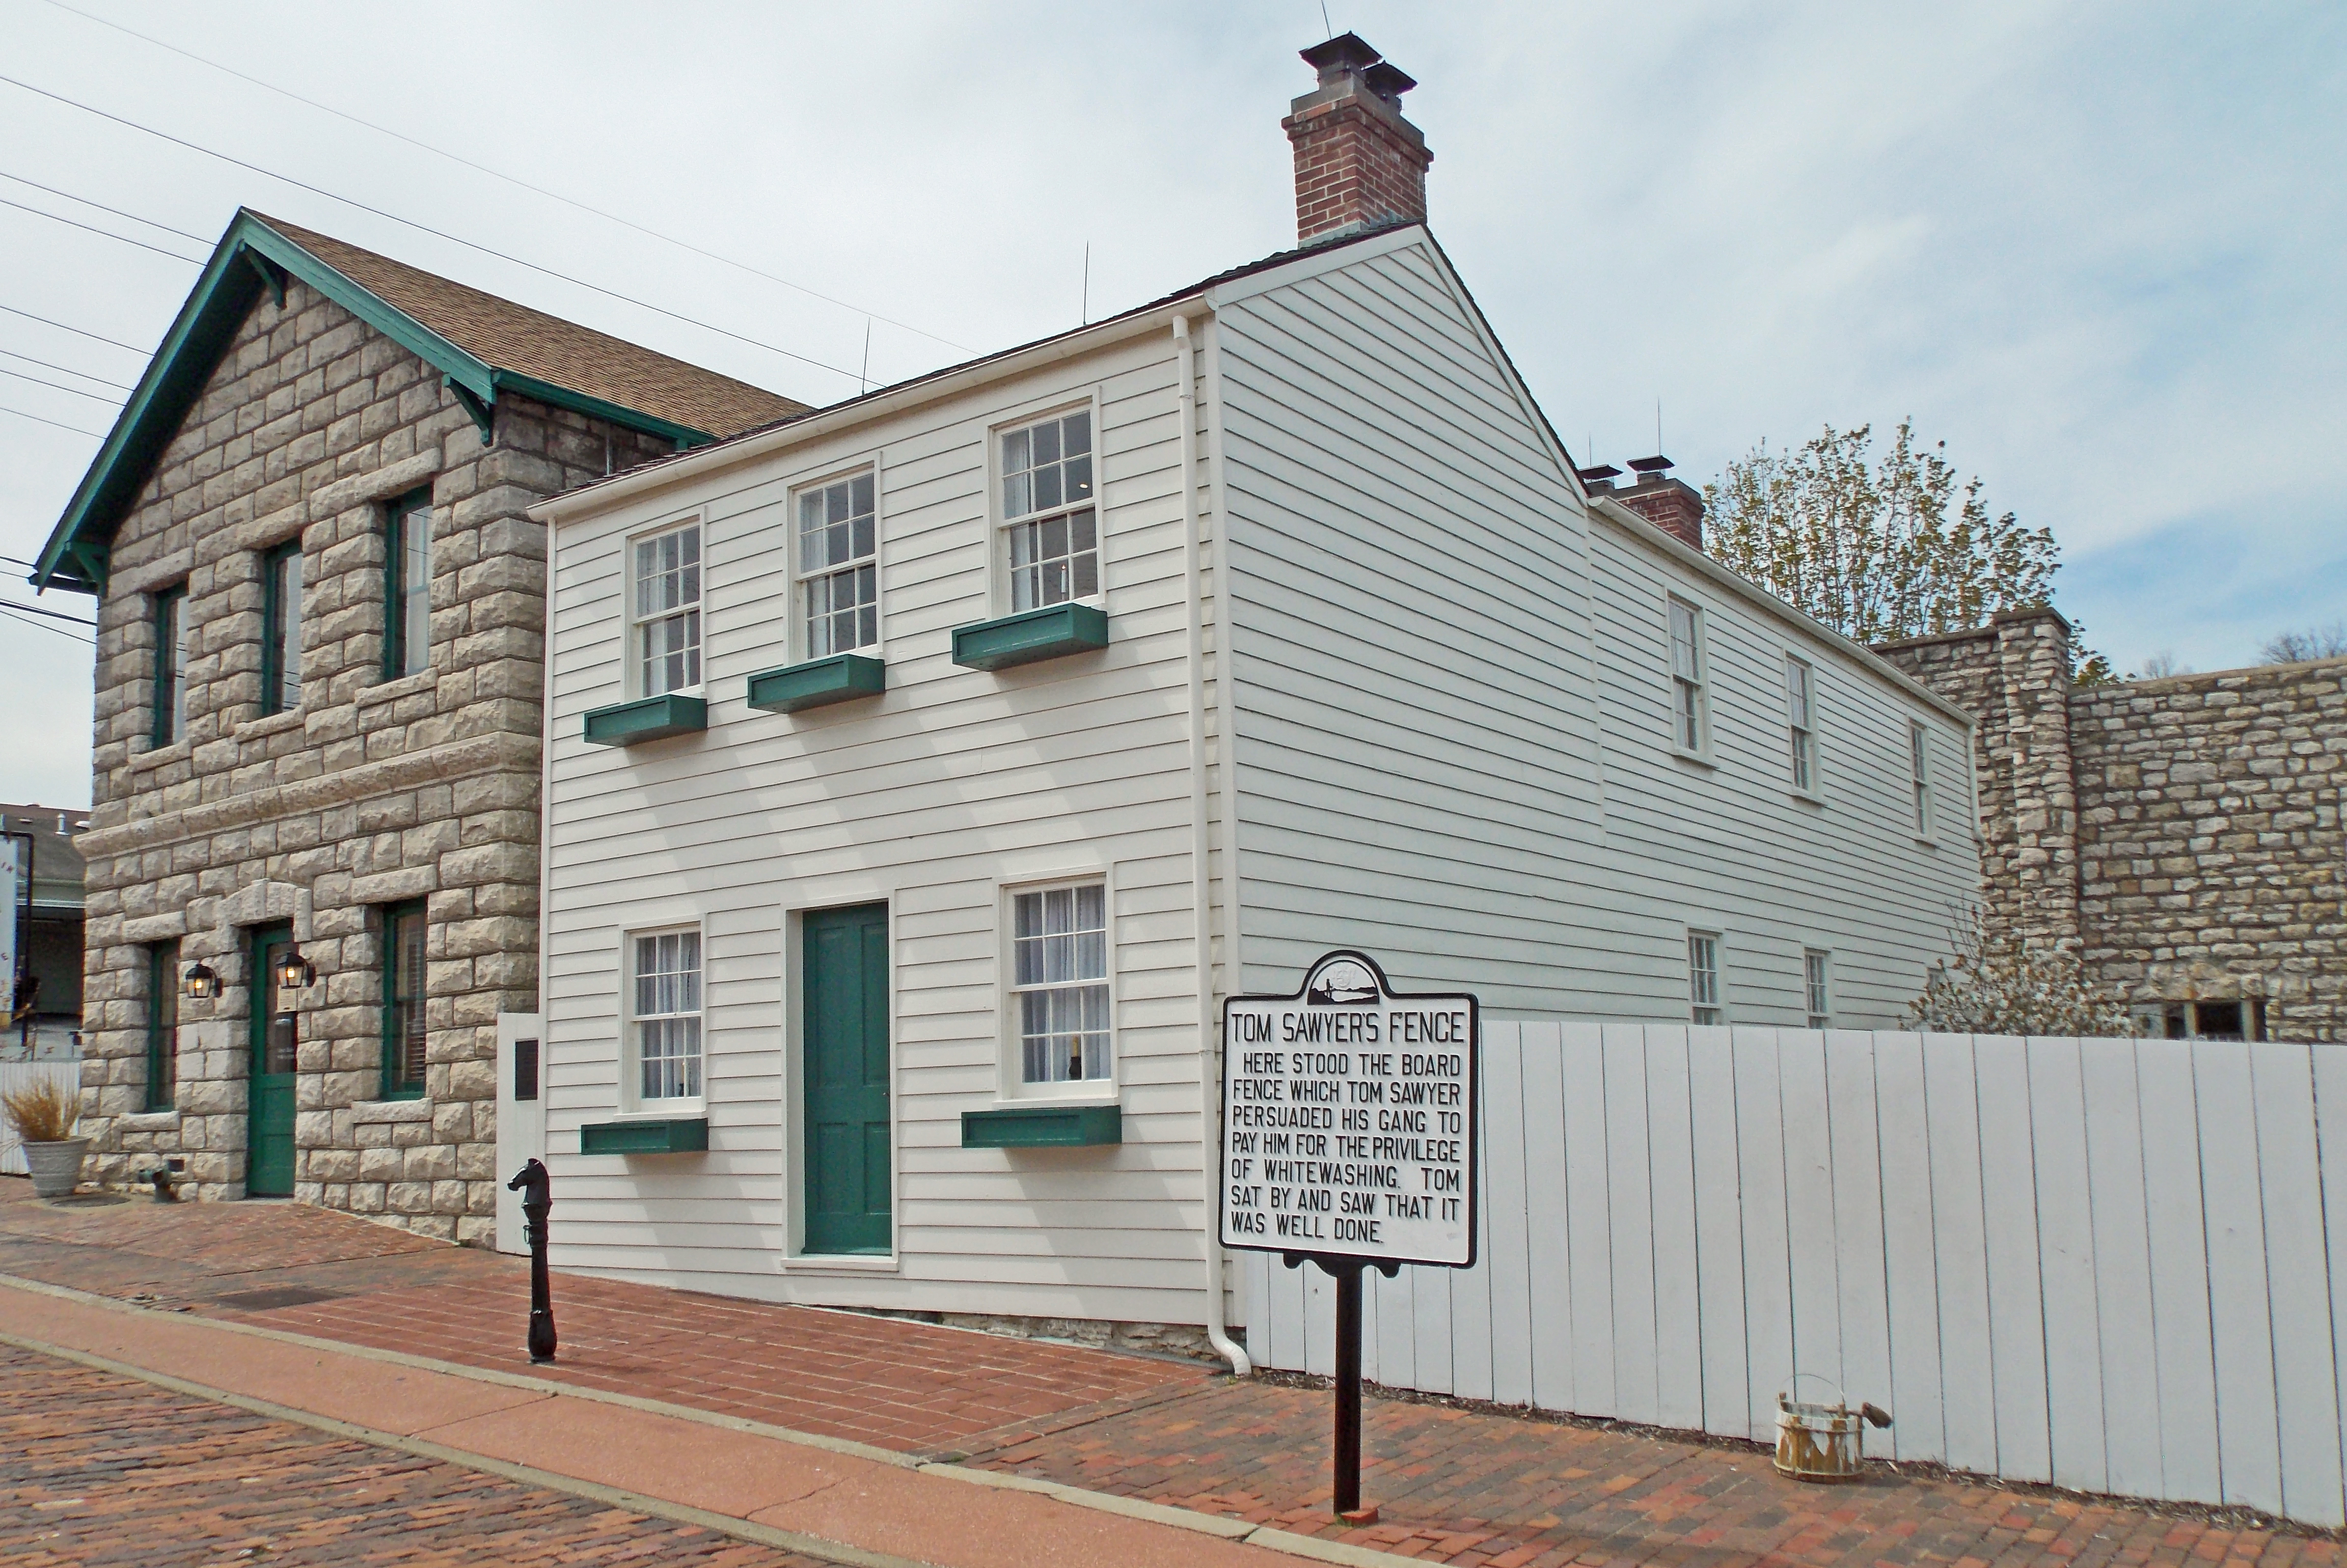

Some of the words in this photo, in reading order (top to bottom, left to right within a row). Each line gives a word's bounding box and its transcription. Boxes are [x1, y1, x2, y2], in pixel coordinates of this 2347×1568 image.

[1231, 1013, 1272, 1043] TOM
[1282, 1012, 1379, 1043] SAWYER'S
[1389, 1011, 1465, 1043] FENCE
[1243, 1052, 1285, 1075] HERE
[1292, 1052, 1349, 1076] STOOD
[1358, 1053, 1393, 1077] THE
[1401, 1053, 1461, 1078] BOARD
[1233, 1078, 1284, 1102] FENCE
[1289, 1079, 1340, 1103] WHICH
[1346, 1080, 1383, 1104] TOM
[1389, 1081, 1461, 1106] SAWYER
[1232, 1105, 1332, 1130] PERSUADED
[1342, 1108, 1369, 1131] HIS
[1378, 1109, 1427, 1134] GANG
[1436, 1110, 1461, 1135] TO
[1232, 1131, 1258, 1154] PAY
[1263, 1132, 1290, 1156] HIM
[1296, 1133, 1327, 1157] FOR
[1334, 1135, 1369, 1159] THE
[1372, 1136, 1461, 1164] PRIVILEGE
[1231, 1158, 1253, 1180] OF
[1264, 1158, 1401, 1189] WHITEWASHING.
[1420, 1167, 1460, 1193] TOM
[1231, 1185, 1262, 1207] SAT
[1270, 1186, 1291, 1209] BY
[1297, 1188, 1331, 1212] AND
[1340, 1191, 1376, 1216] SAW
[1384, 1193, 1434, 1220] THAT
[1441, 1197, 1460, 1222] IT
[1231, 1211, 1266, 1234] WAS
[1275, 1213, 1325, 1239] WELL
[1334, 1217, 1384, 1244] DONE.
